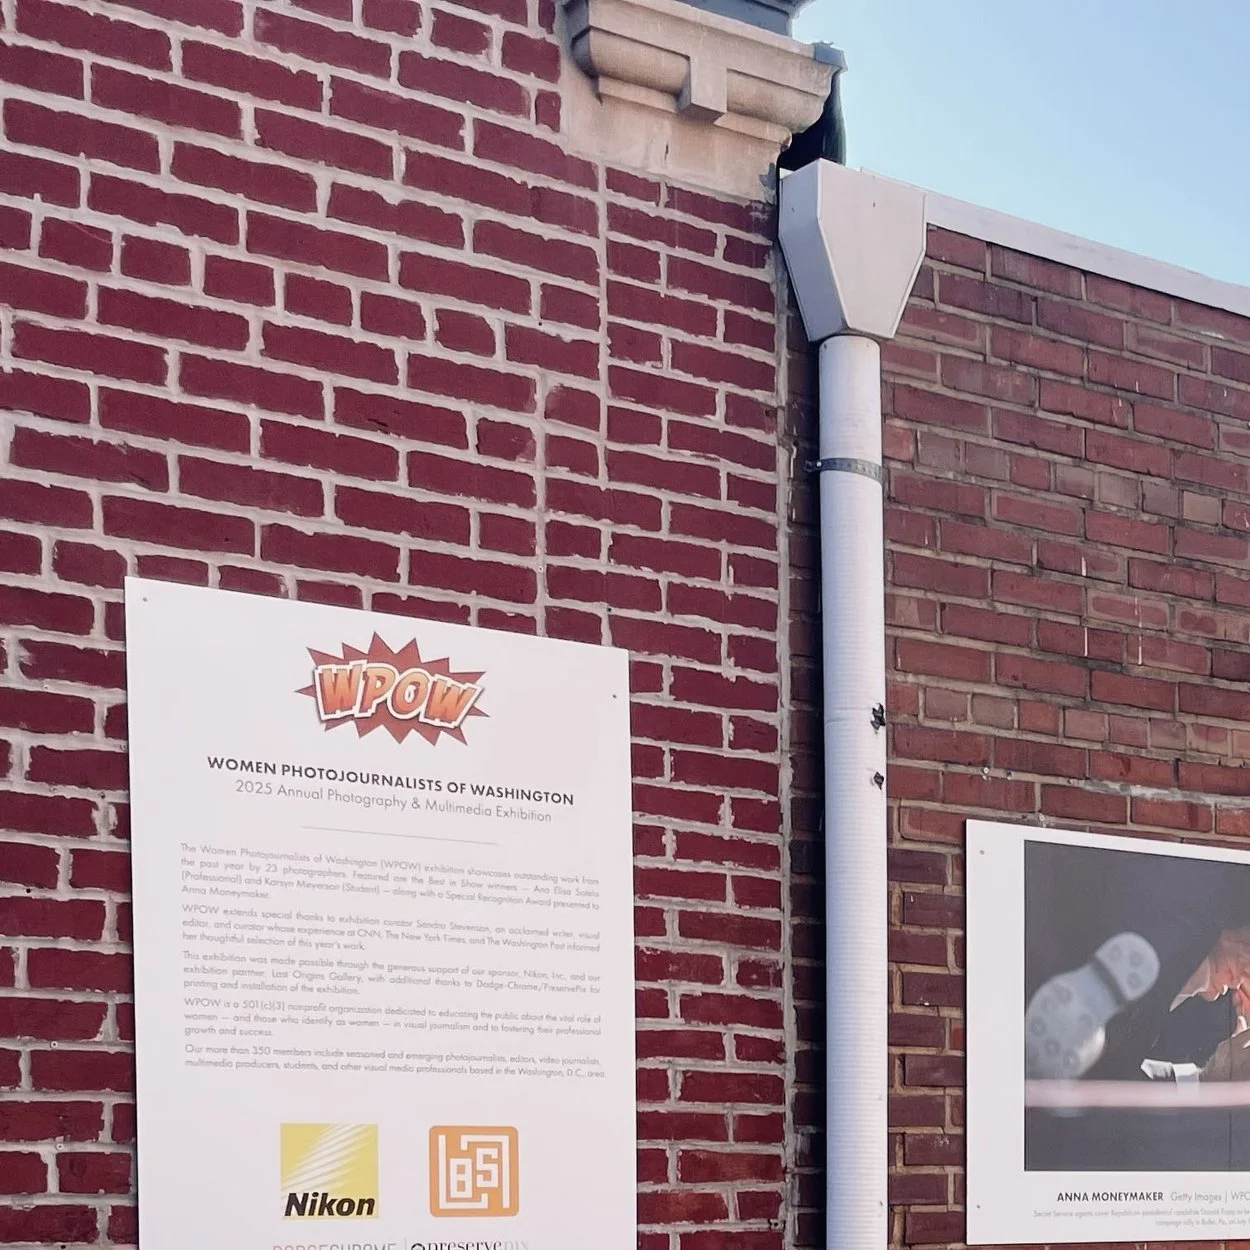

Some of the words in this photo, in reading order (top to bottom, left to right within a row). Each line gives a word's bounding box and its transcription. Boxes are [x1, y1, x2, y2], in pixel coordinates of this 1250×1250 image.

[316, 660, 482, 728] WPOW
[208, 755, 276, 776] WOMEN
[282, 763, 442, 793] PHOTOJOURNALISTS
[447, 780, 466, 795] OF
[470, 782, 573, 806] WASHINGTON
[236, 779, 273, 796] 2025
[277, 783, 323, 801] Annual
[327, 788, 407, 814] Photography
[411, 796, 421, 810] &
[425, 798, 492, 817] Multimedia
[496, 805, 551, 823] Exhibition
[313, 854, 322, 863] of
[265, 864, 278, 873] 23
[184, 997, 221, 1007] WPOW
[252, 1046, 271, 1055] 350
[1057, 1192, 1088, 1202] ANNA
[1092, 1192, 1163, 1202] MONEYMAKER
[1171, 1192, 1192, 1203] Getty
[1194, 1192, 1222, 1203] Images
[284, 1192, 375, 1216] Nikon
